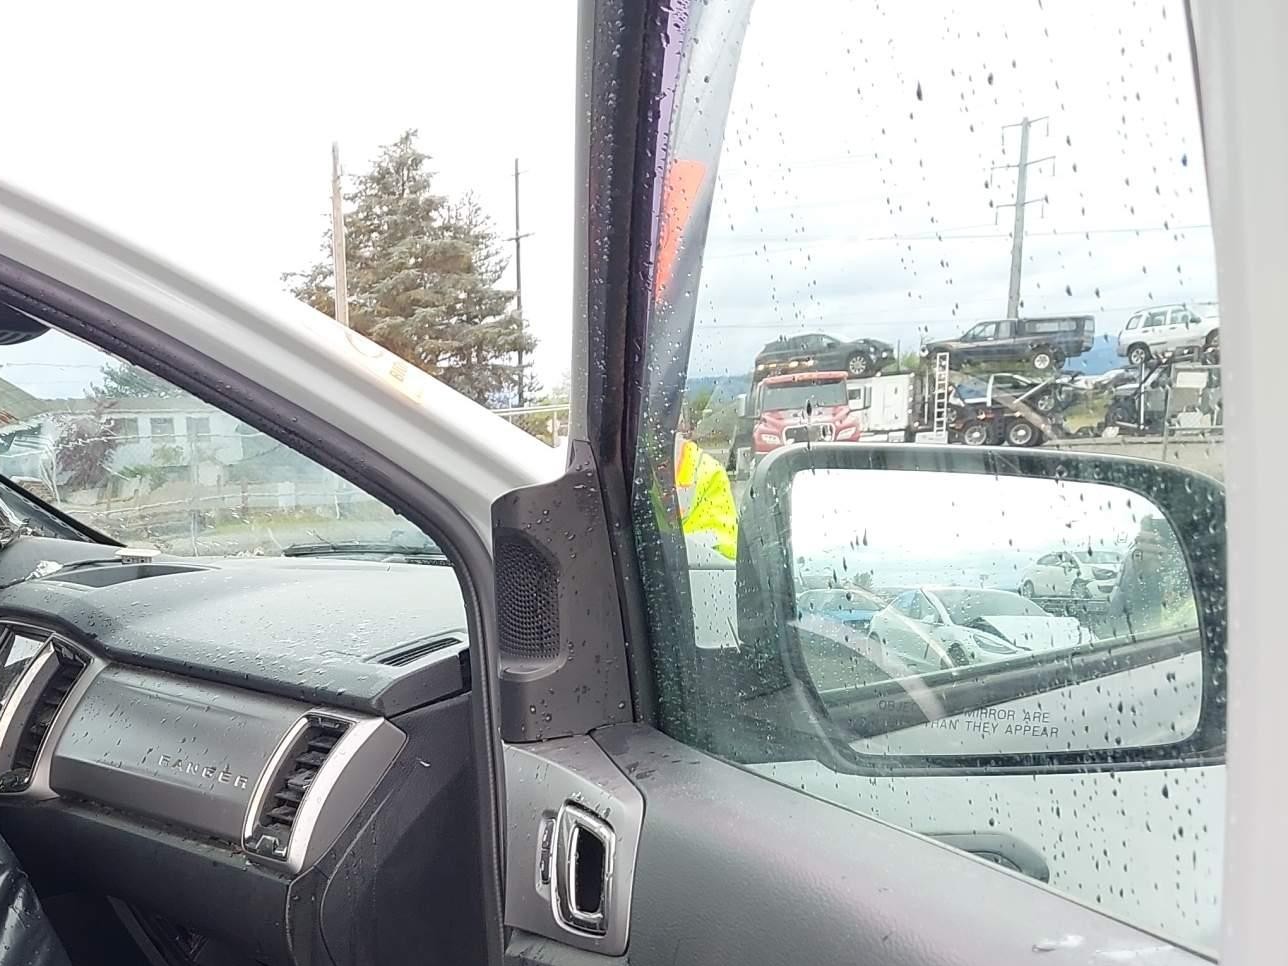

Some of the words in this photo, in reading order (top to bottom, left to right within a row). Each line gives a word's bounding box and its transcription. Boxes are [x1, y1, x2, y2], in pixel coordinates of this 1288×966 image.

[964, 708, 1016, 721] MIRROR
[1023, 711, 1050, 723] ARE
[964, 720, 1000, 734] THEY
[1004, 724, 1060, 738] APPEAR
[158, 753, 249, 790] RANGER
